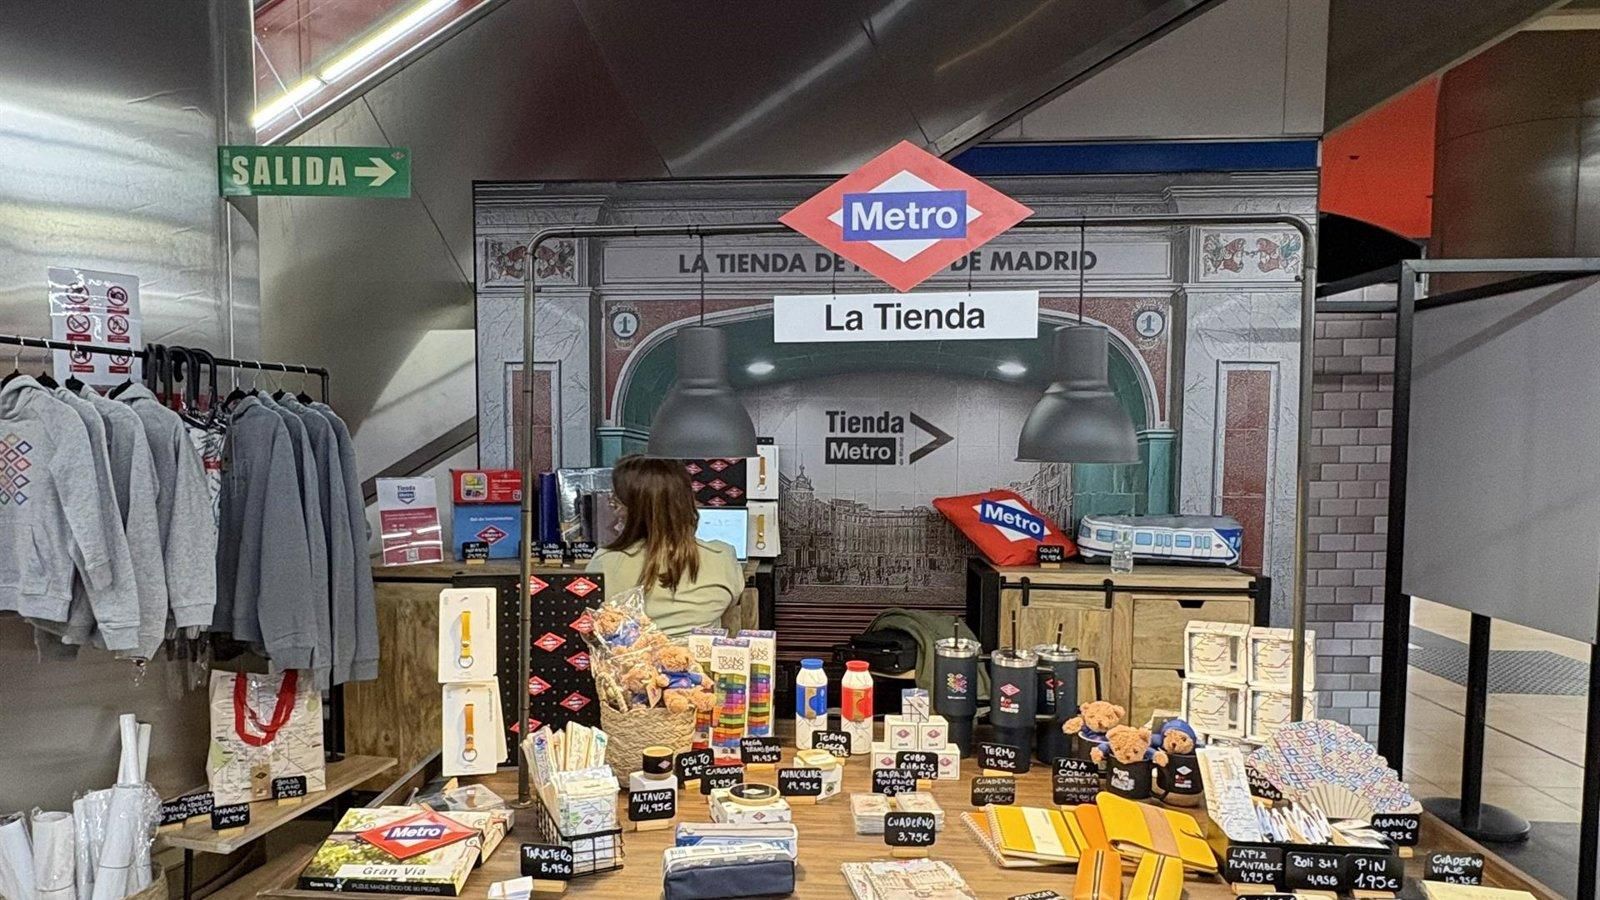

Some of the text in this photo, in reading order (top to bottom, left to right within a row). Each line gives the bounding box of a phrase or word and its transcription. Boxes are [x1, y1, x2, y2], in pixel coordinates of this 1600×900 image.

[232, 156, 346, 186] SALIDA
[851, 201, 958, 231] Metro
[679, 254, 709, 273] LA
[716, 253, 806, 273] TIENDA
[815, 253, 845, 273] DE
[990, 250, 1097, 271] MADRID
[825, 303, 985, 331] La Tienda
[825, 410, 904, 434] Tienda
[829, 442, 891, 460] Metro
[984, 503, 1041, 535] Metro
[903, 753, 926, 762] CUBO
[982, 745, 1016, 759] TERMO
[632, 791, 672, 803] ALTAVOZ
[887, 816, 934, 829] CUADERNO
[390, 826, 442, 838] Metro
[1228, 859, 1283, 871] PLANTABLE
[1432, 854, 1483, 867] CUADERNO
[362, 866, 427, 876] Gran Vía
